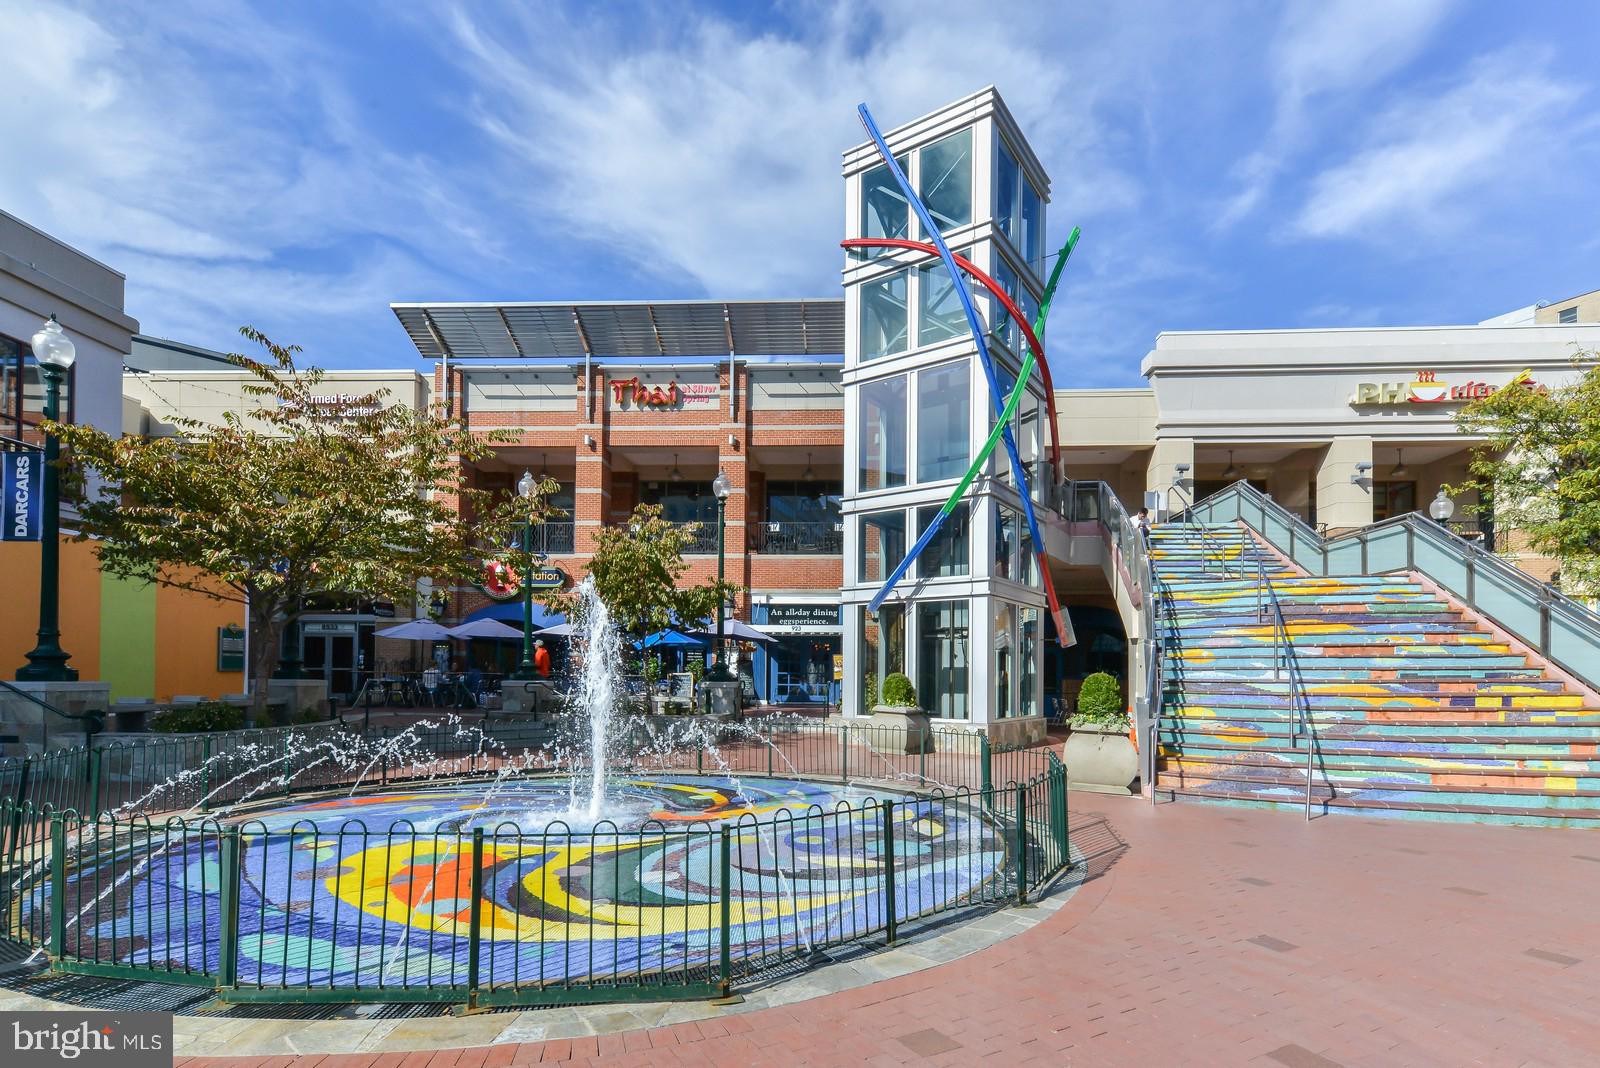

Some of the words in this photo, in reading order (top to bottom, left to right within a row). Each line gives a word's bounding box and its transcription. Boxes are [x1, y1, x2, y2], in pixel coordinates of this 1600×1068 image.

[608, 377, 677, 405] Thai
[692, 384, 716, 393] Silver
[304, 393, 338, 404] rmed
[15, 456, 30, 537] DARCARS
[770, 608, 783, 616] An
[812, 608, 839, 618] dining
[779, 618, 829, 626] eggsperience.
